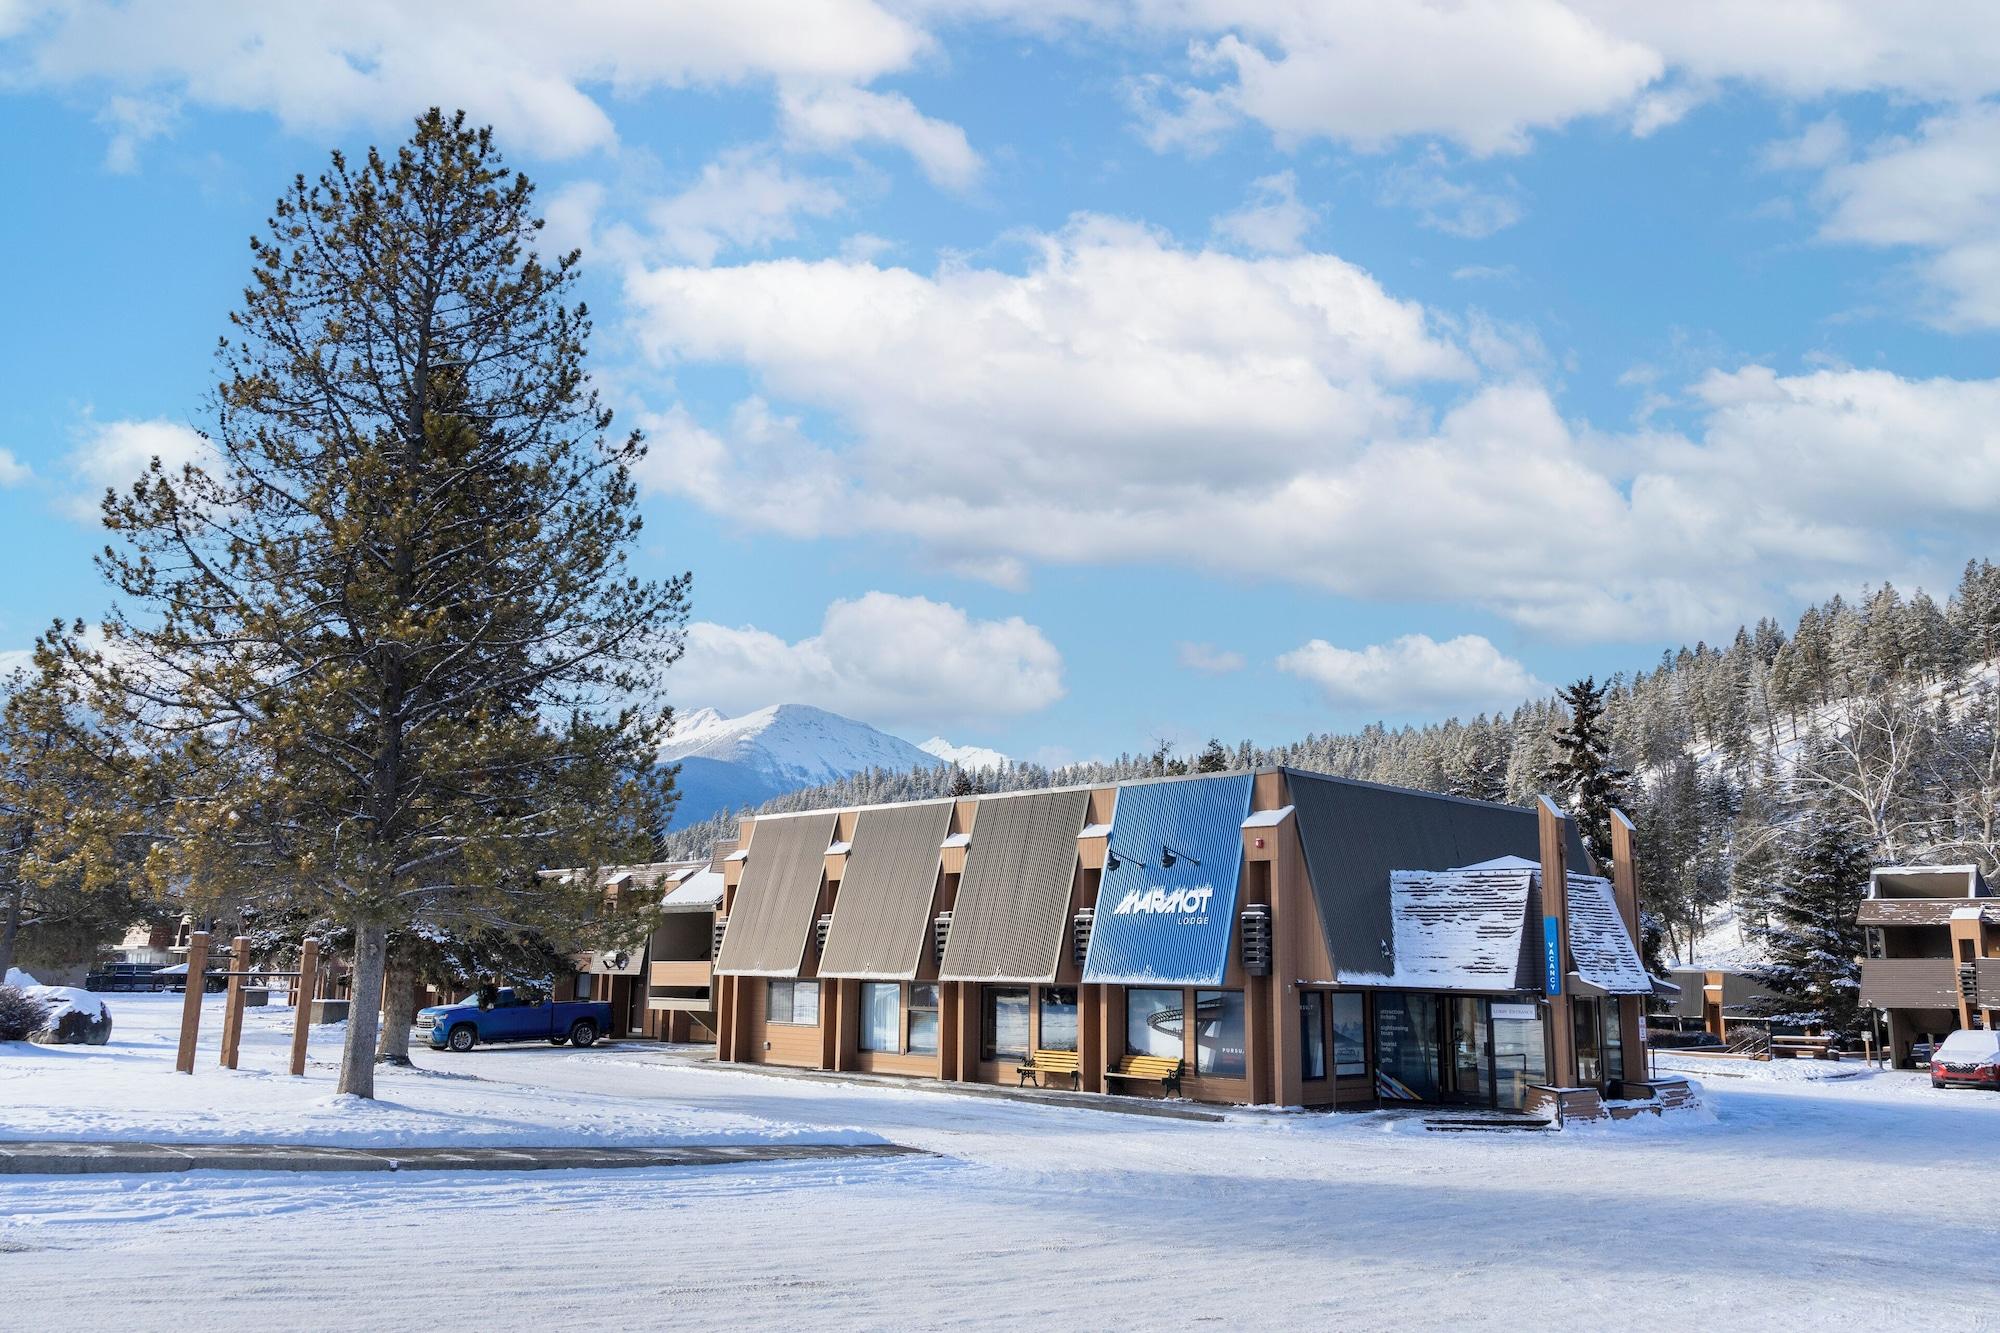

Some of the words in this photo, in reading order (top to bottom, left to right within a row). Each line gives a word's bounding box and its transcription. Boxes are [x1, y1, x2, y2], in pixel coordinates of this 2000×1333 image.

[1113, 884, 1213, 915] MARMOT
[1178, 917, 1208, 925] LODGE
[1548, 942, 1556, 990] VACANCY
